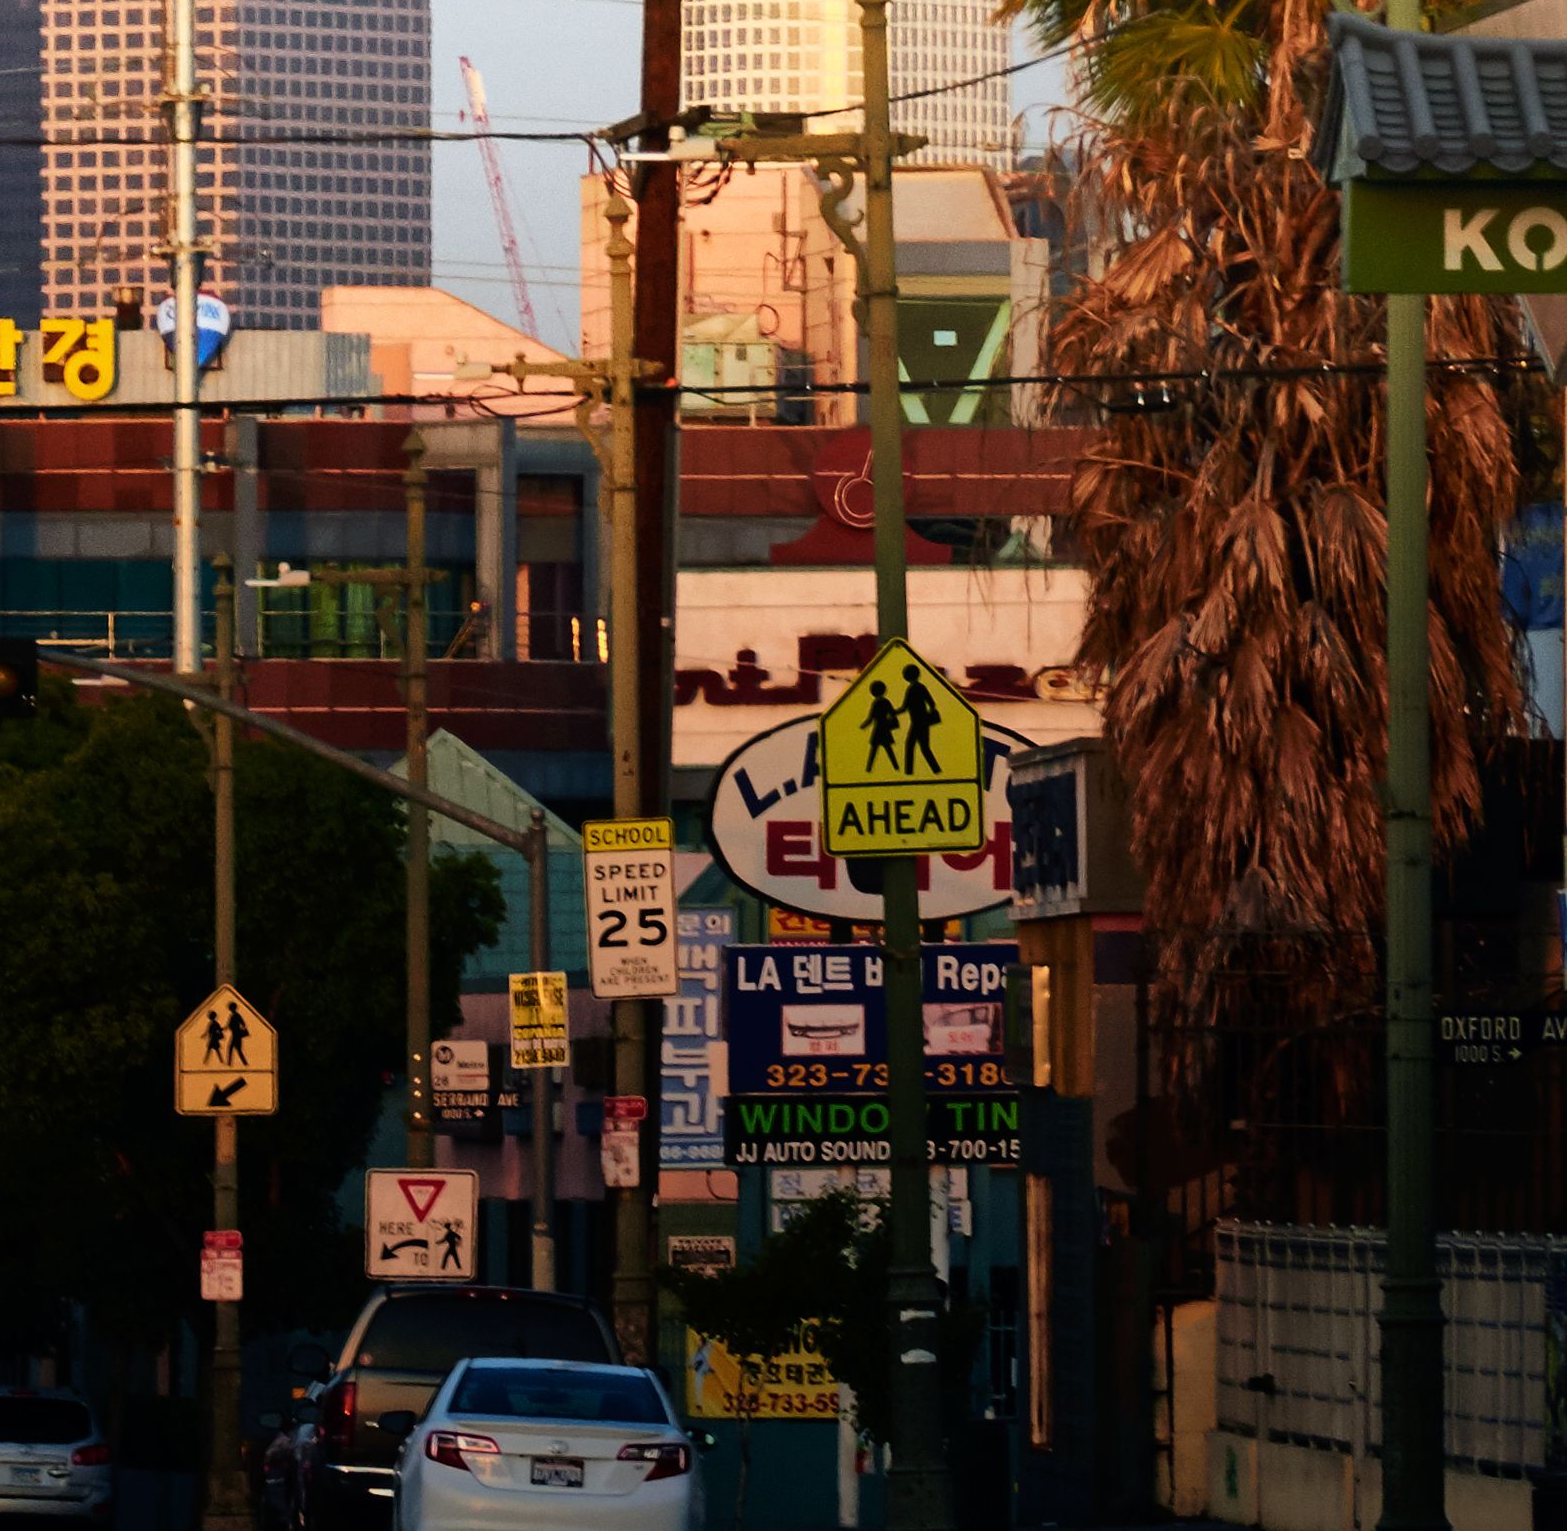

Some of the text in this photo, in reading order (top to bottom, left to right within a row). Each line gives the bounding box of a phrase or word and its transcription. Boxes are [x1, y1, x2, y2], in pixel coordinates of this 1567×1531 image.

[837, 797, 971, 835] AHEAD
[589, 826, 667, 846] SCHOOL
[594, 863, 666, 880] SPEED
[602, 885, 659, 903] LIMIT
[597, 908, 668, 948] 25
[736, 955, 782, 992] LA
[792, 953, 855, 995] 덴트
[1440, 1015, 1567, 1041] OXFORD AV
[766, 1061, 1019, 1089] 323-73-318
[432, 1092, 521, 1107] SERRANO AVE
[738, 1101, 929, 1135] WINDO
[735, 1142, 758, 1164] JJ
[763, 1141, 815, 1163] AUTO
[820, 1140, 892, 1163] SOUND
[925, 1139, 1021, 1161] 3-700-15
[379, 1221, 414, 1235] HERE
[413, 1252, 429, 1267] TO
